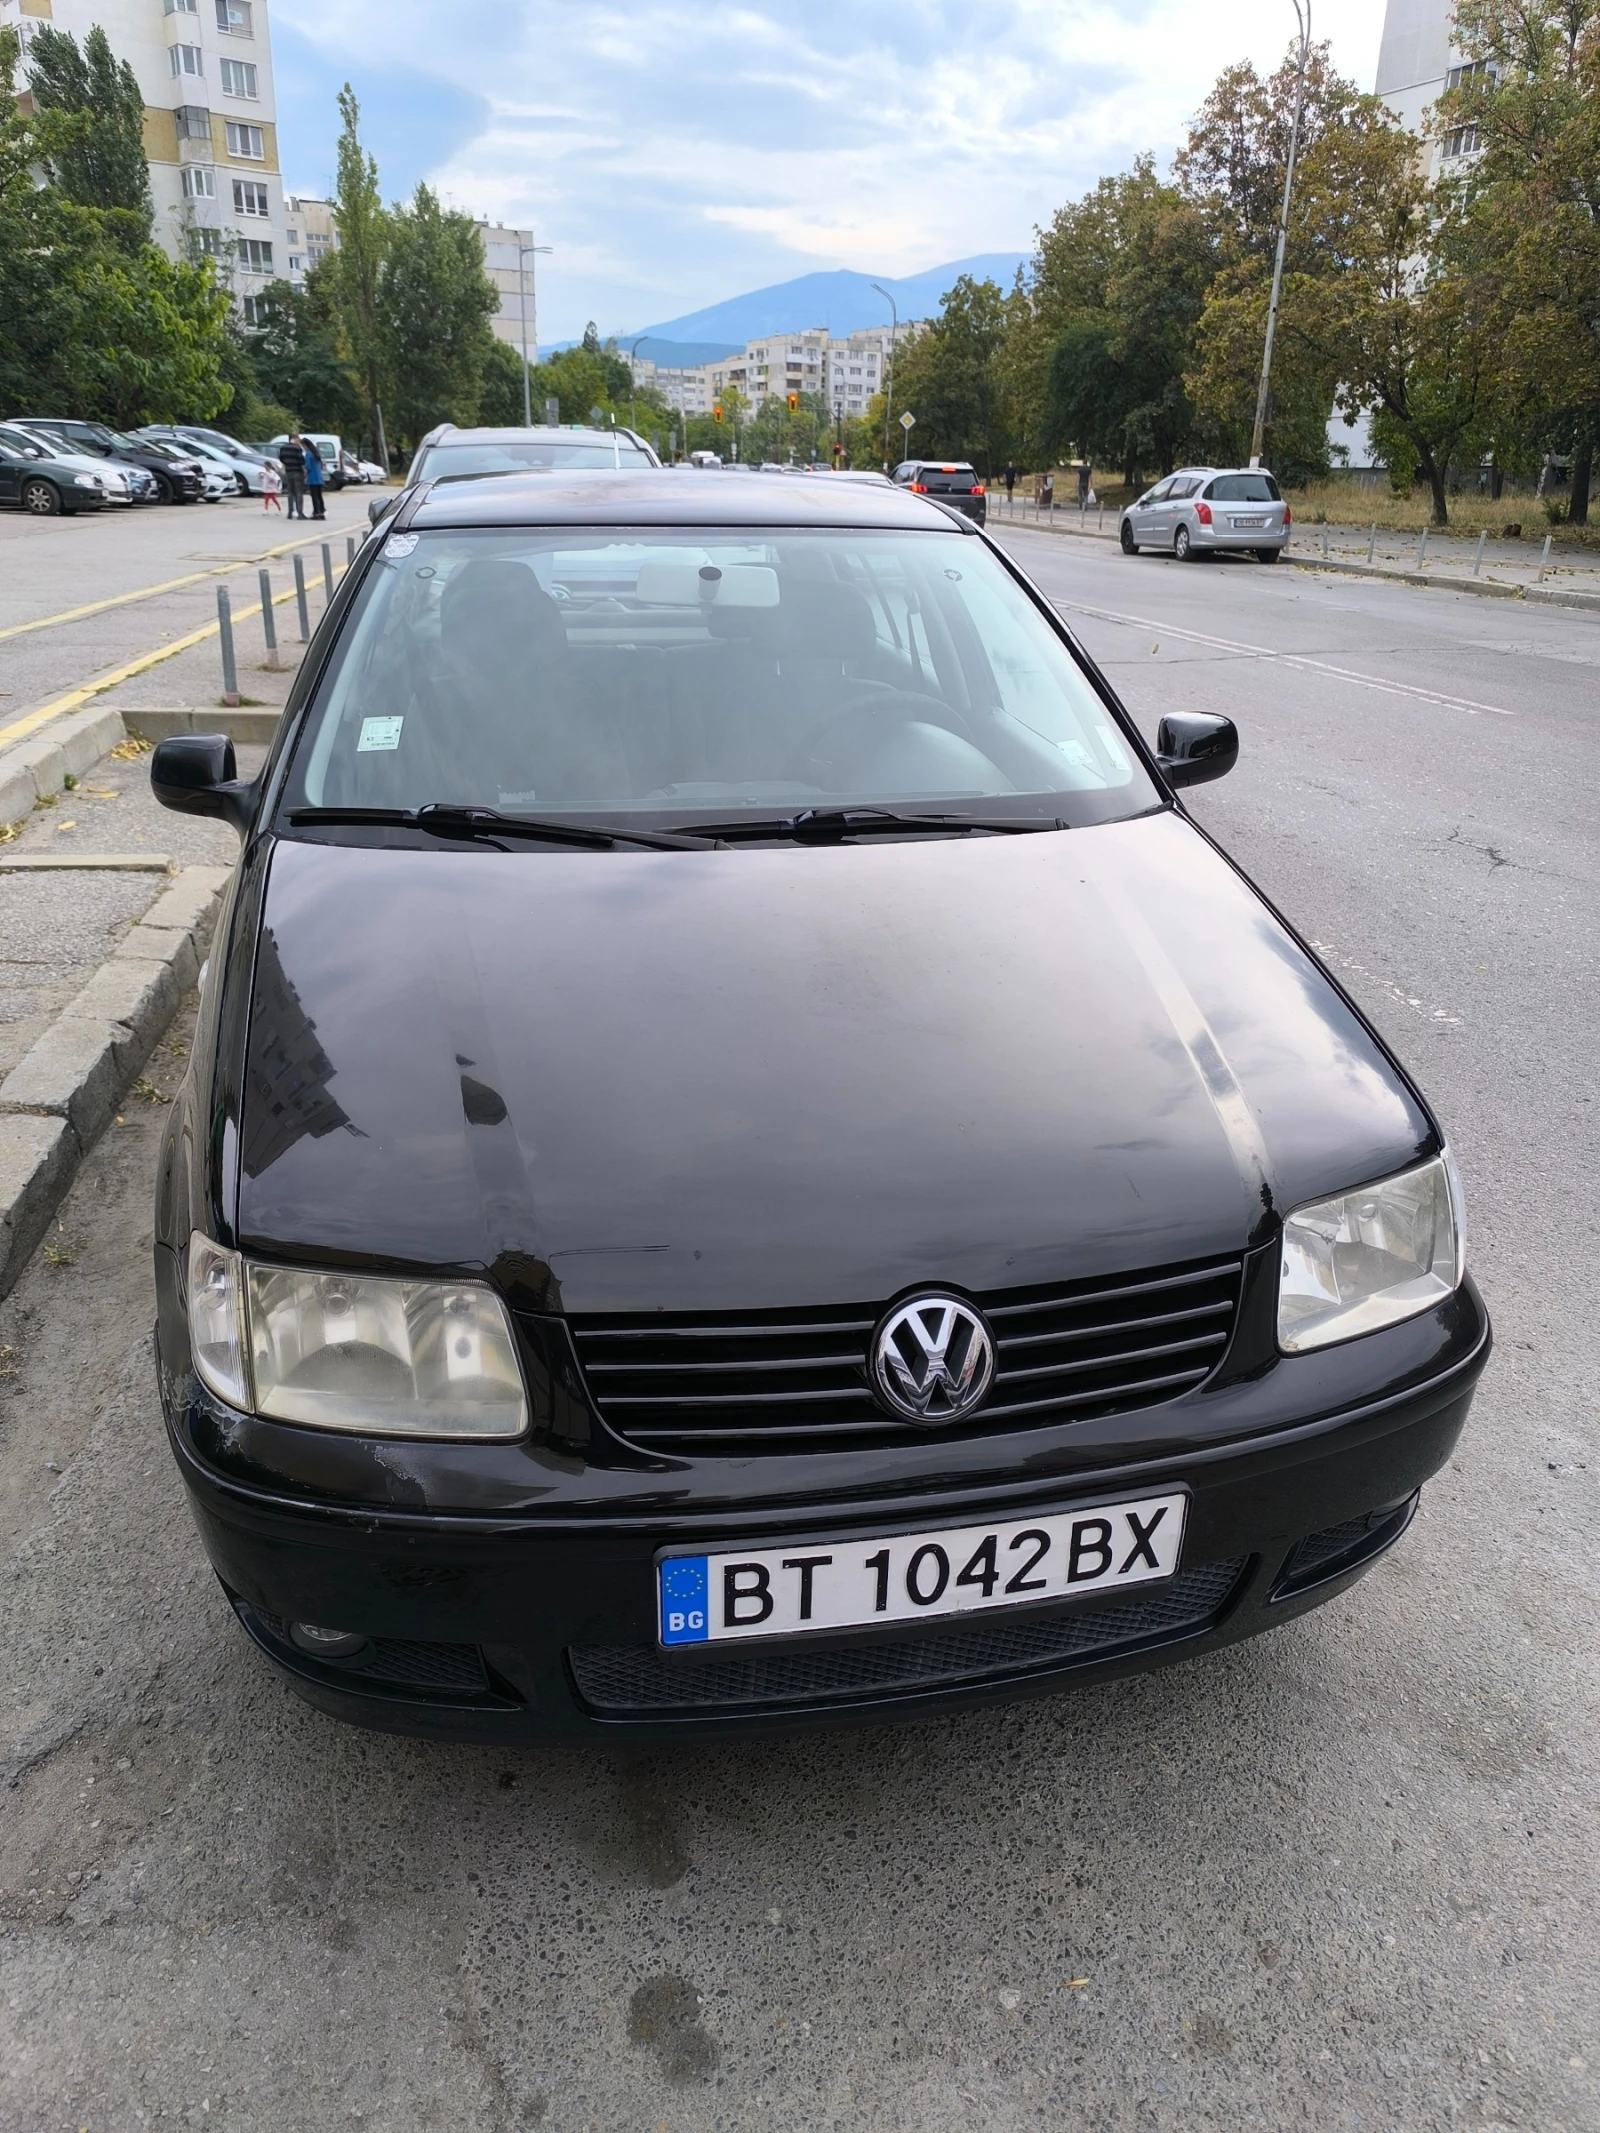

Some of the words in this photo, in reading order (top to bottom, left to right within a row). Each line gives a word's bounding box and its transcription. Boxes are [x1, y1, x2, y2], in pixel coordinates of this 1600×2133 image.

[876, 1298, 994, 1417] VW
[669, 1610, 704, 1632] BG
[723, 1555, 832, 1628] BT
[865, 1529, 1052, 1612] 1042
[1067, 1506, 1169, 1584] BX
